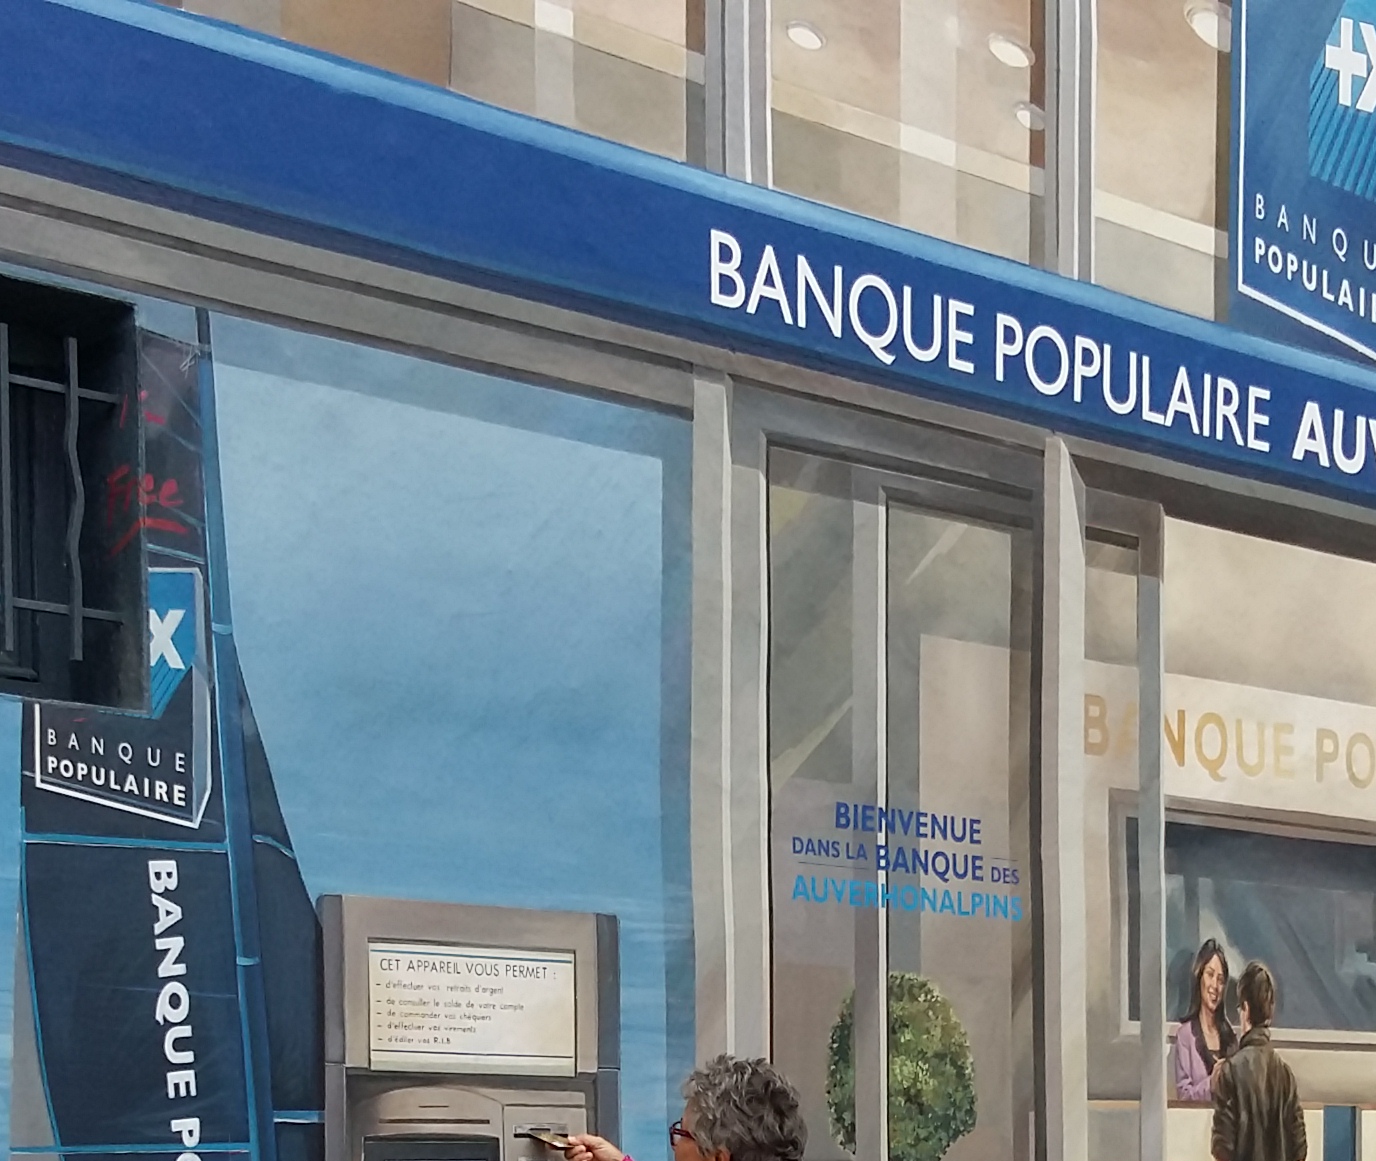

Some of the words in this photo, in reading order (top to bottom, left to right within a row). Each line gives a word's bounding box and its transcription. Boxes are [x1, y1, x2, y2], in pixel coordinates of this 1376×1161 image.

[709, 228, 975, 375] BANQUE
[994, 313, 1271, 453] POPULAIRE
[47, 728, 187, 774] BANQUE
[47, 755, 187, 807] POPULAIRE
[834, 801, 982, 845] BIENVENUE
[792, 836, 840, 859] DANS
[845, 842, 868, 861] LA
[876, 844, 984, 883] BANQUE
[991, 866, 1020, 885] DES
[792, 874, 1023, 922] AUVERHONALPINS
[147, 859, 199, 1100] BANQUE
[379, 958, 401, 971] CET
[407, 959, 461, 975] APPAREIL
[465, 962, 500, 977] VOUS
[505, 964, 548, 980] PERMET
